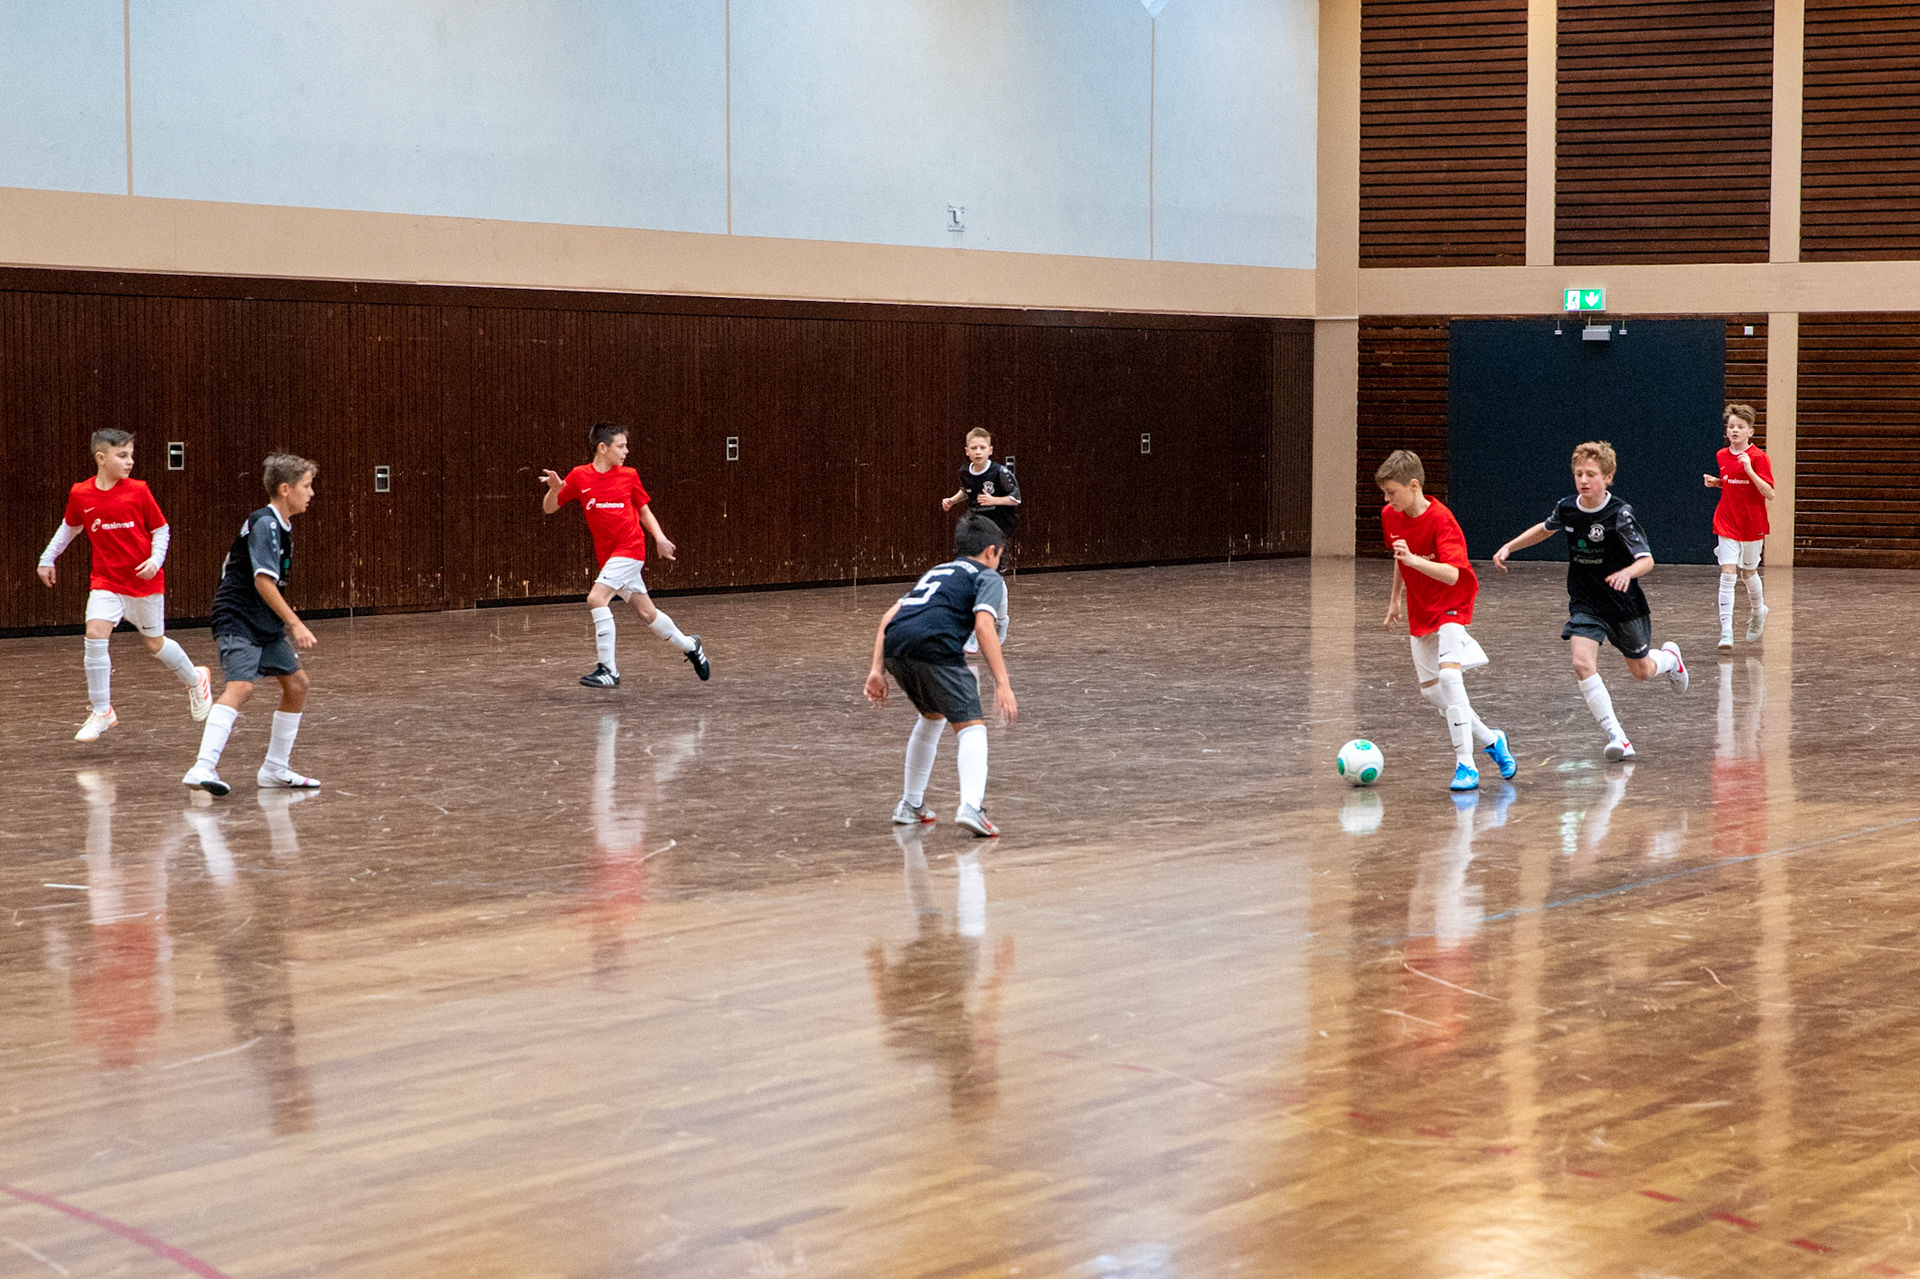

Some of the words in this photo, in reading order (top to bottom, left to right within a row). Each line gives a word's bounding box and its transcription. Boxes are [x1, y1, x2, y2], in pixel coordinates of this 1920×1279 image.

[595, 501, 625, 509] mainova
[101, 521, 135, 530] mainova
[902, 568, 956, 606] 5
